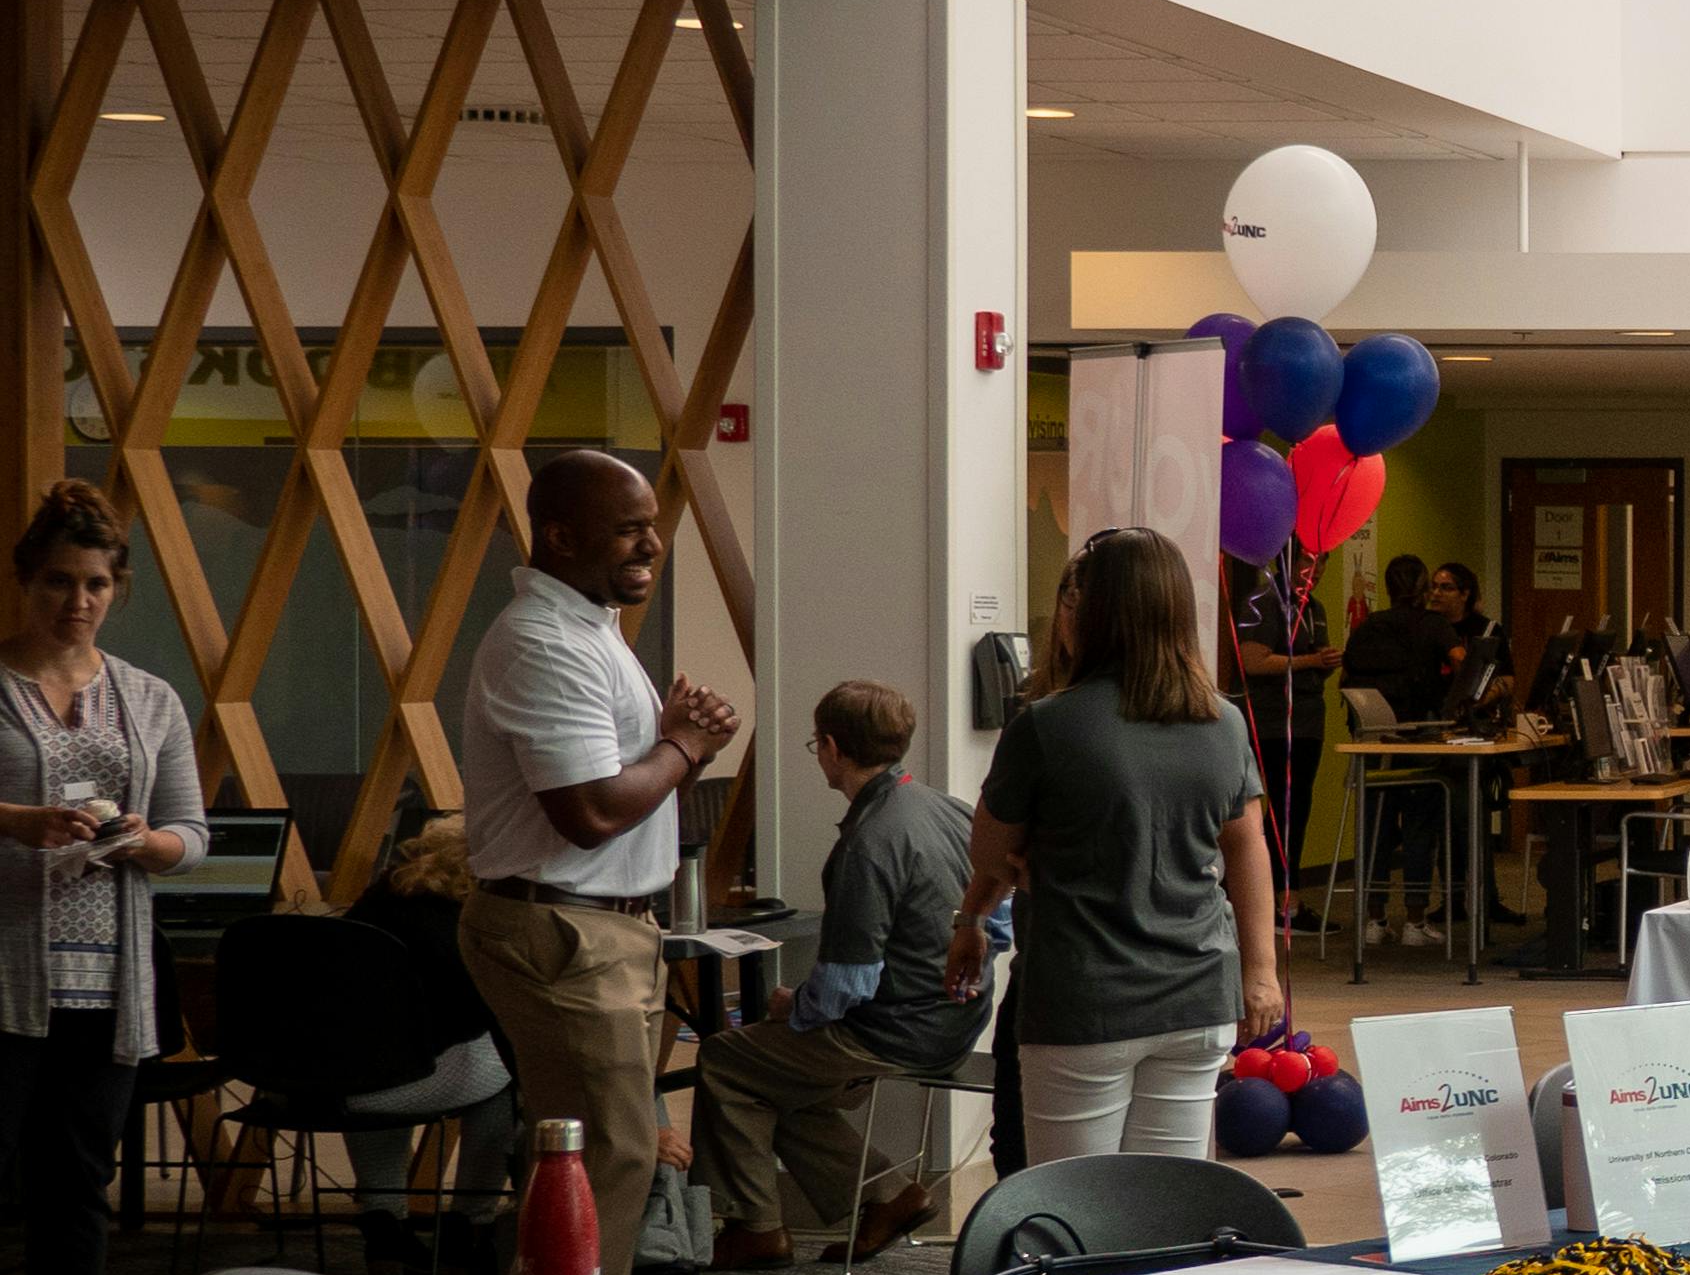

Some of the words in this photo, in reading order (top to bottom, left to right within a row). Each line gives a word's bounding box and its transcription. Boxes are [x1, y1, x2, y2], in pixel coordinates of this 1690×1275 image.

[1399, 1083, 1499, 1114] Aims2UNC
[1608, 1153, 1644, 1164] University
[1654, 1147, 1685, 1159] Northern
